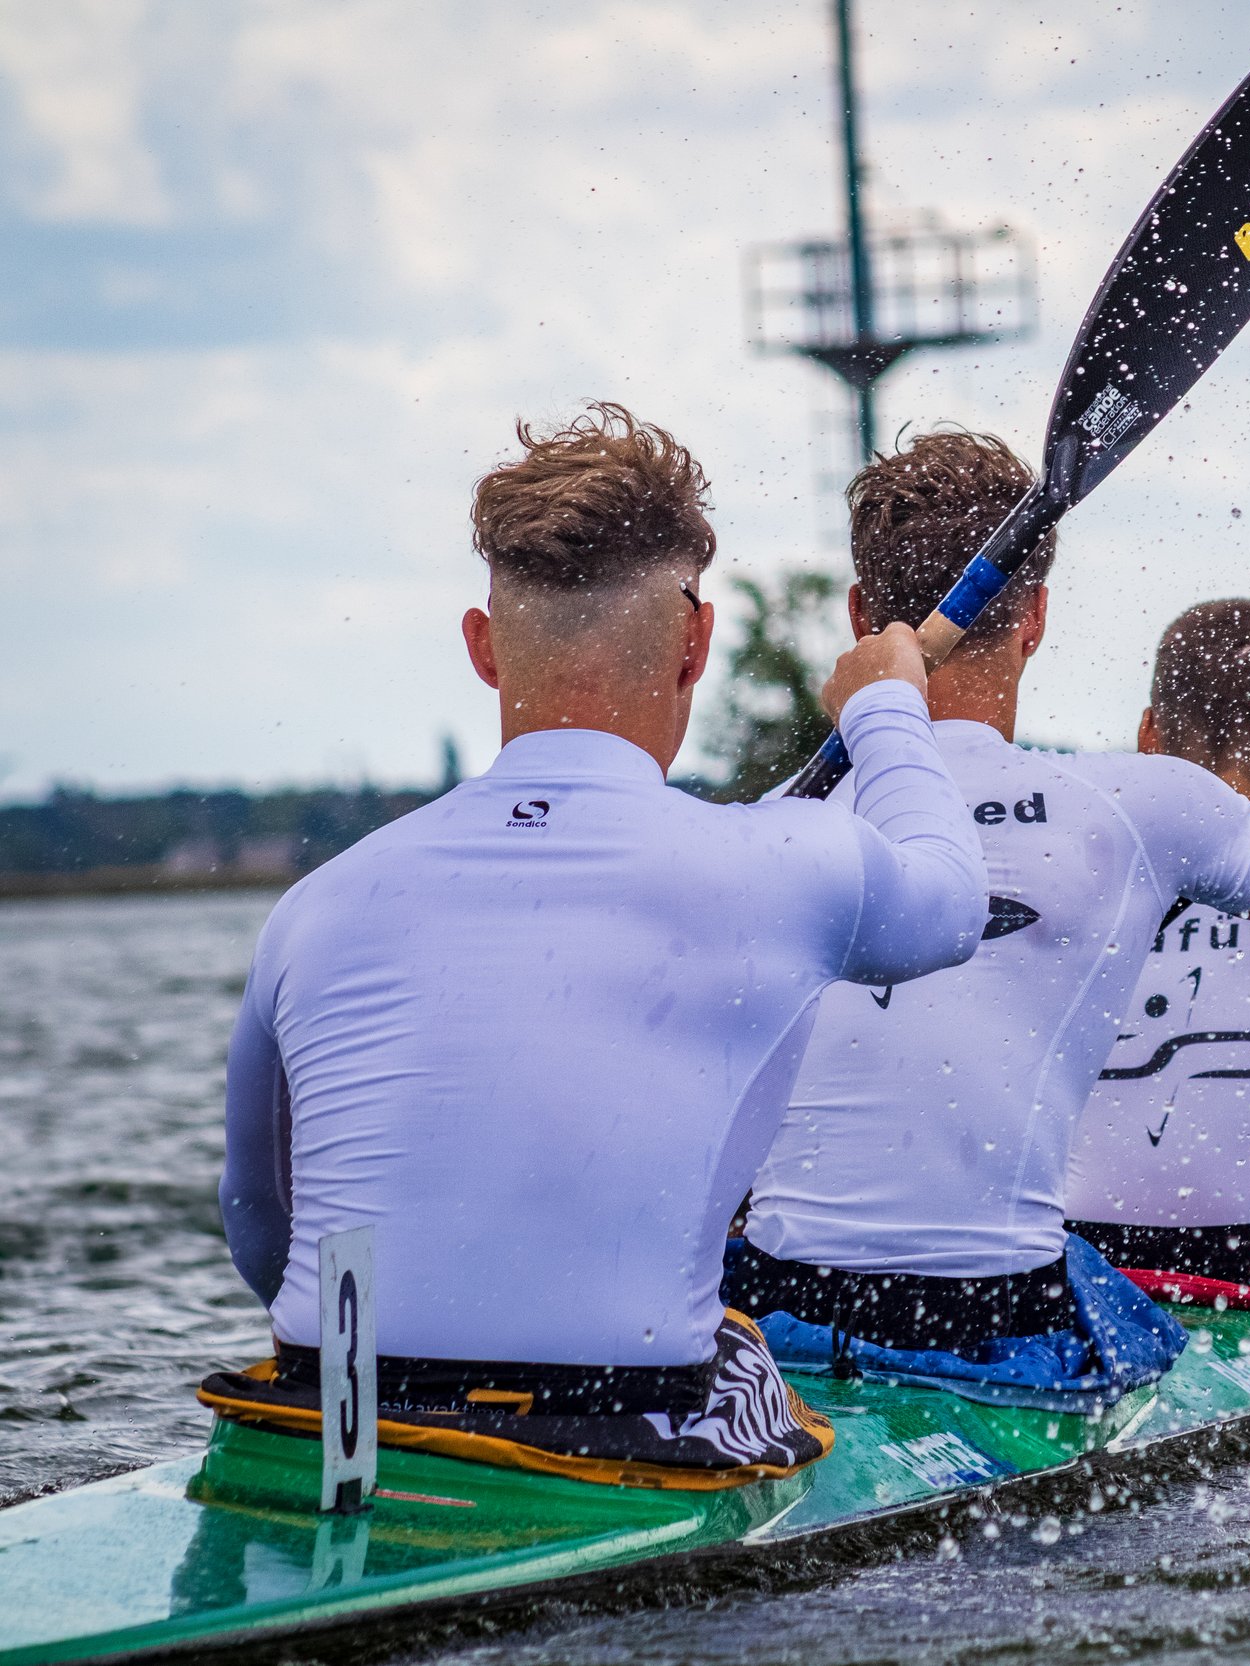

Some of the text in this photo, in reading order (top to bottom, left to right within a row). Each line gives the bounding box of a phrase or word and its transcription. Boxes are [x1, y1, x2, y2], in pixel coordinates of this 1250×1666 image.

[1083, 388, 1121, 431] canoe
[1090, 395, 1129, 437] federation
[1100, 427, 1118, 449] ICF
[505, 820, 547, 828] Sondico
[973, 792, 1048, 825] ed
[338, 1269, 359, 1460] 3
